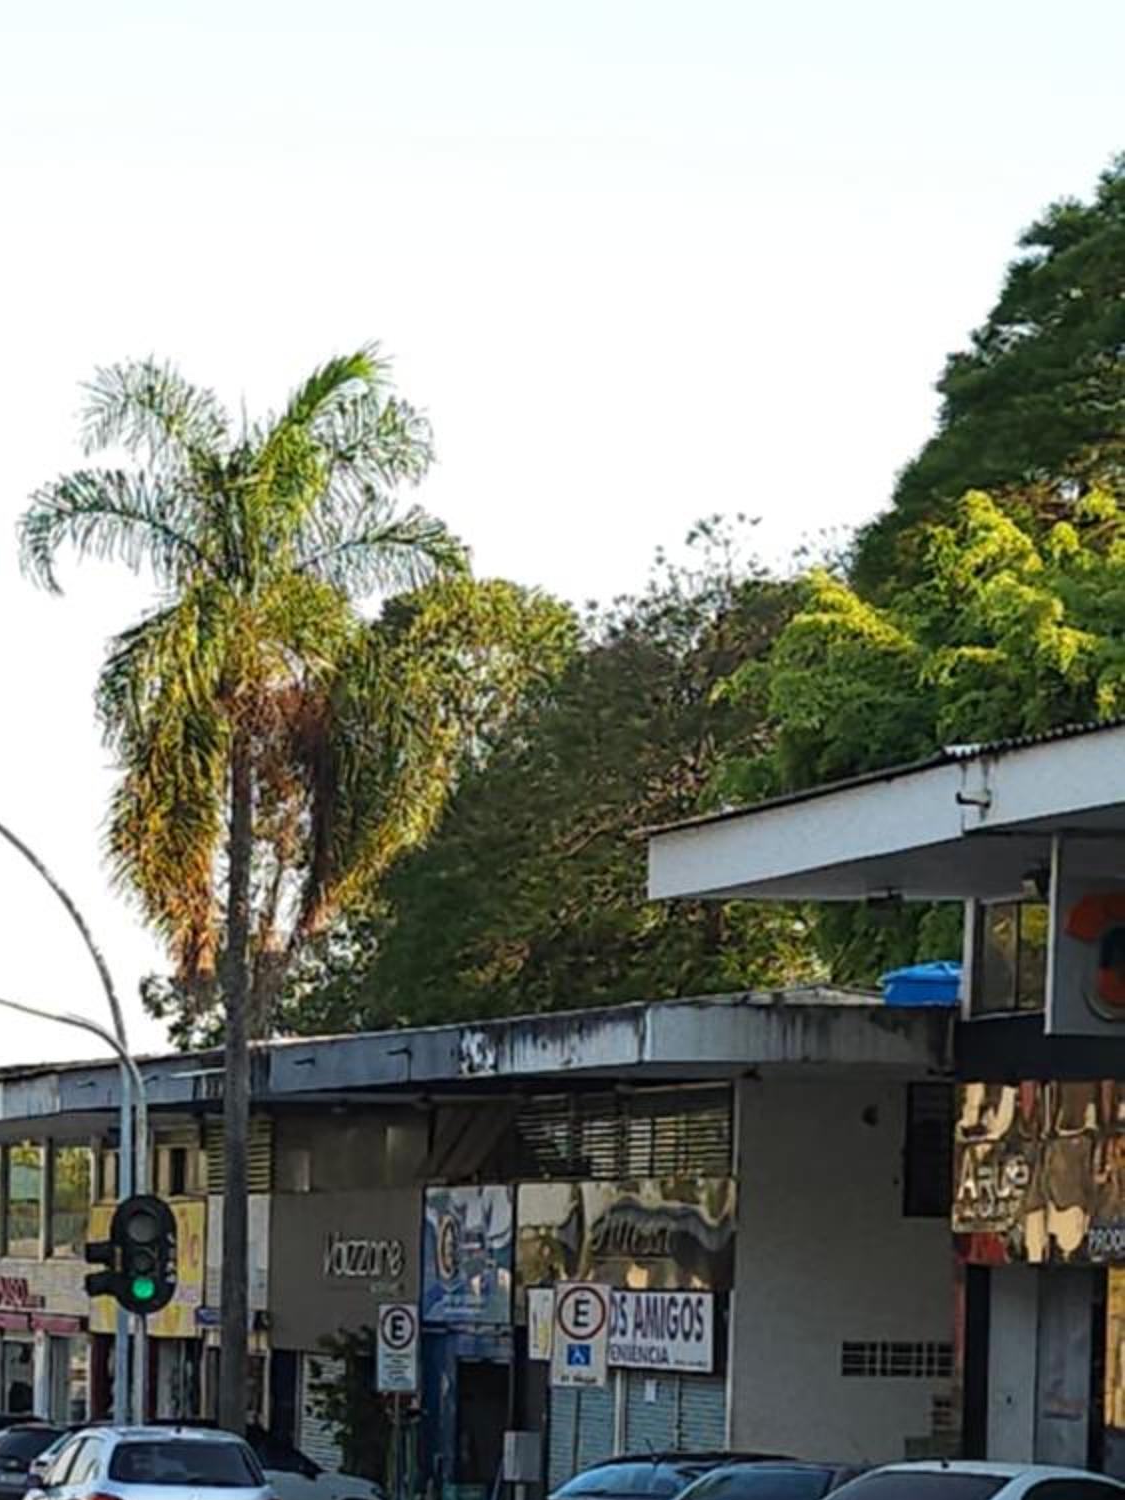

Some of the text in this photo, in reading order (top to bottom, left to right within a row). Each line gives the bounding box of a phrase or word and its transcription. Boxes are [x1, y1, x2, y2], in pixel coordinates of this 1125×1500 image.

[391, 1315, 405, 1341] E
[573, 1299, 591, 1328] E
[632, 1295, 705, 1342] AMIGOS
